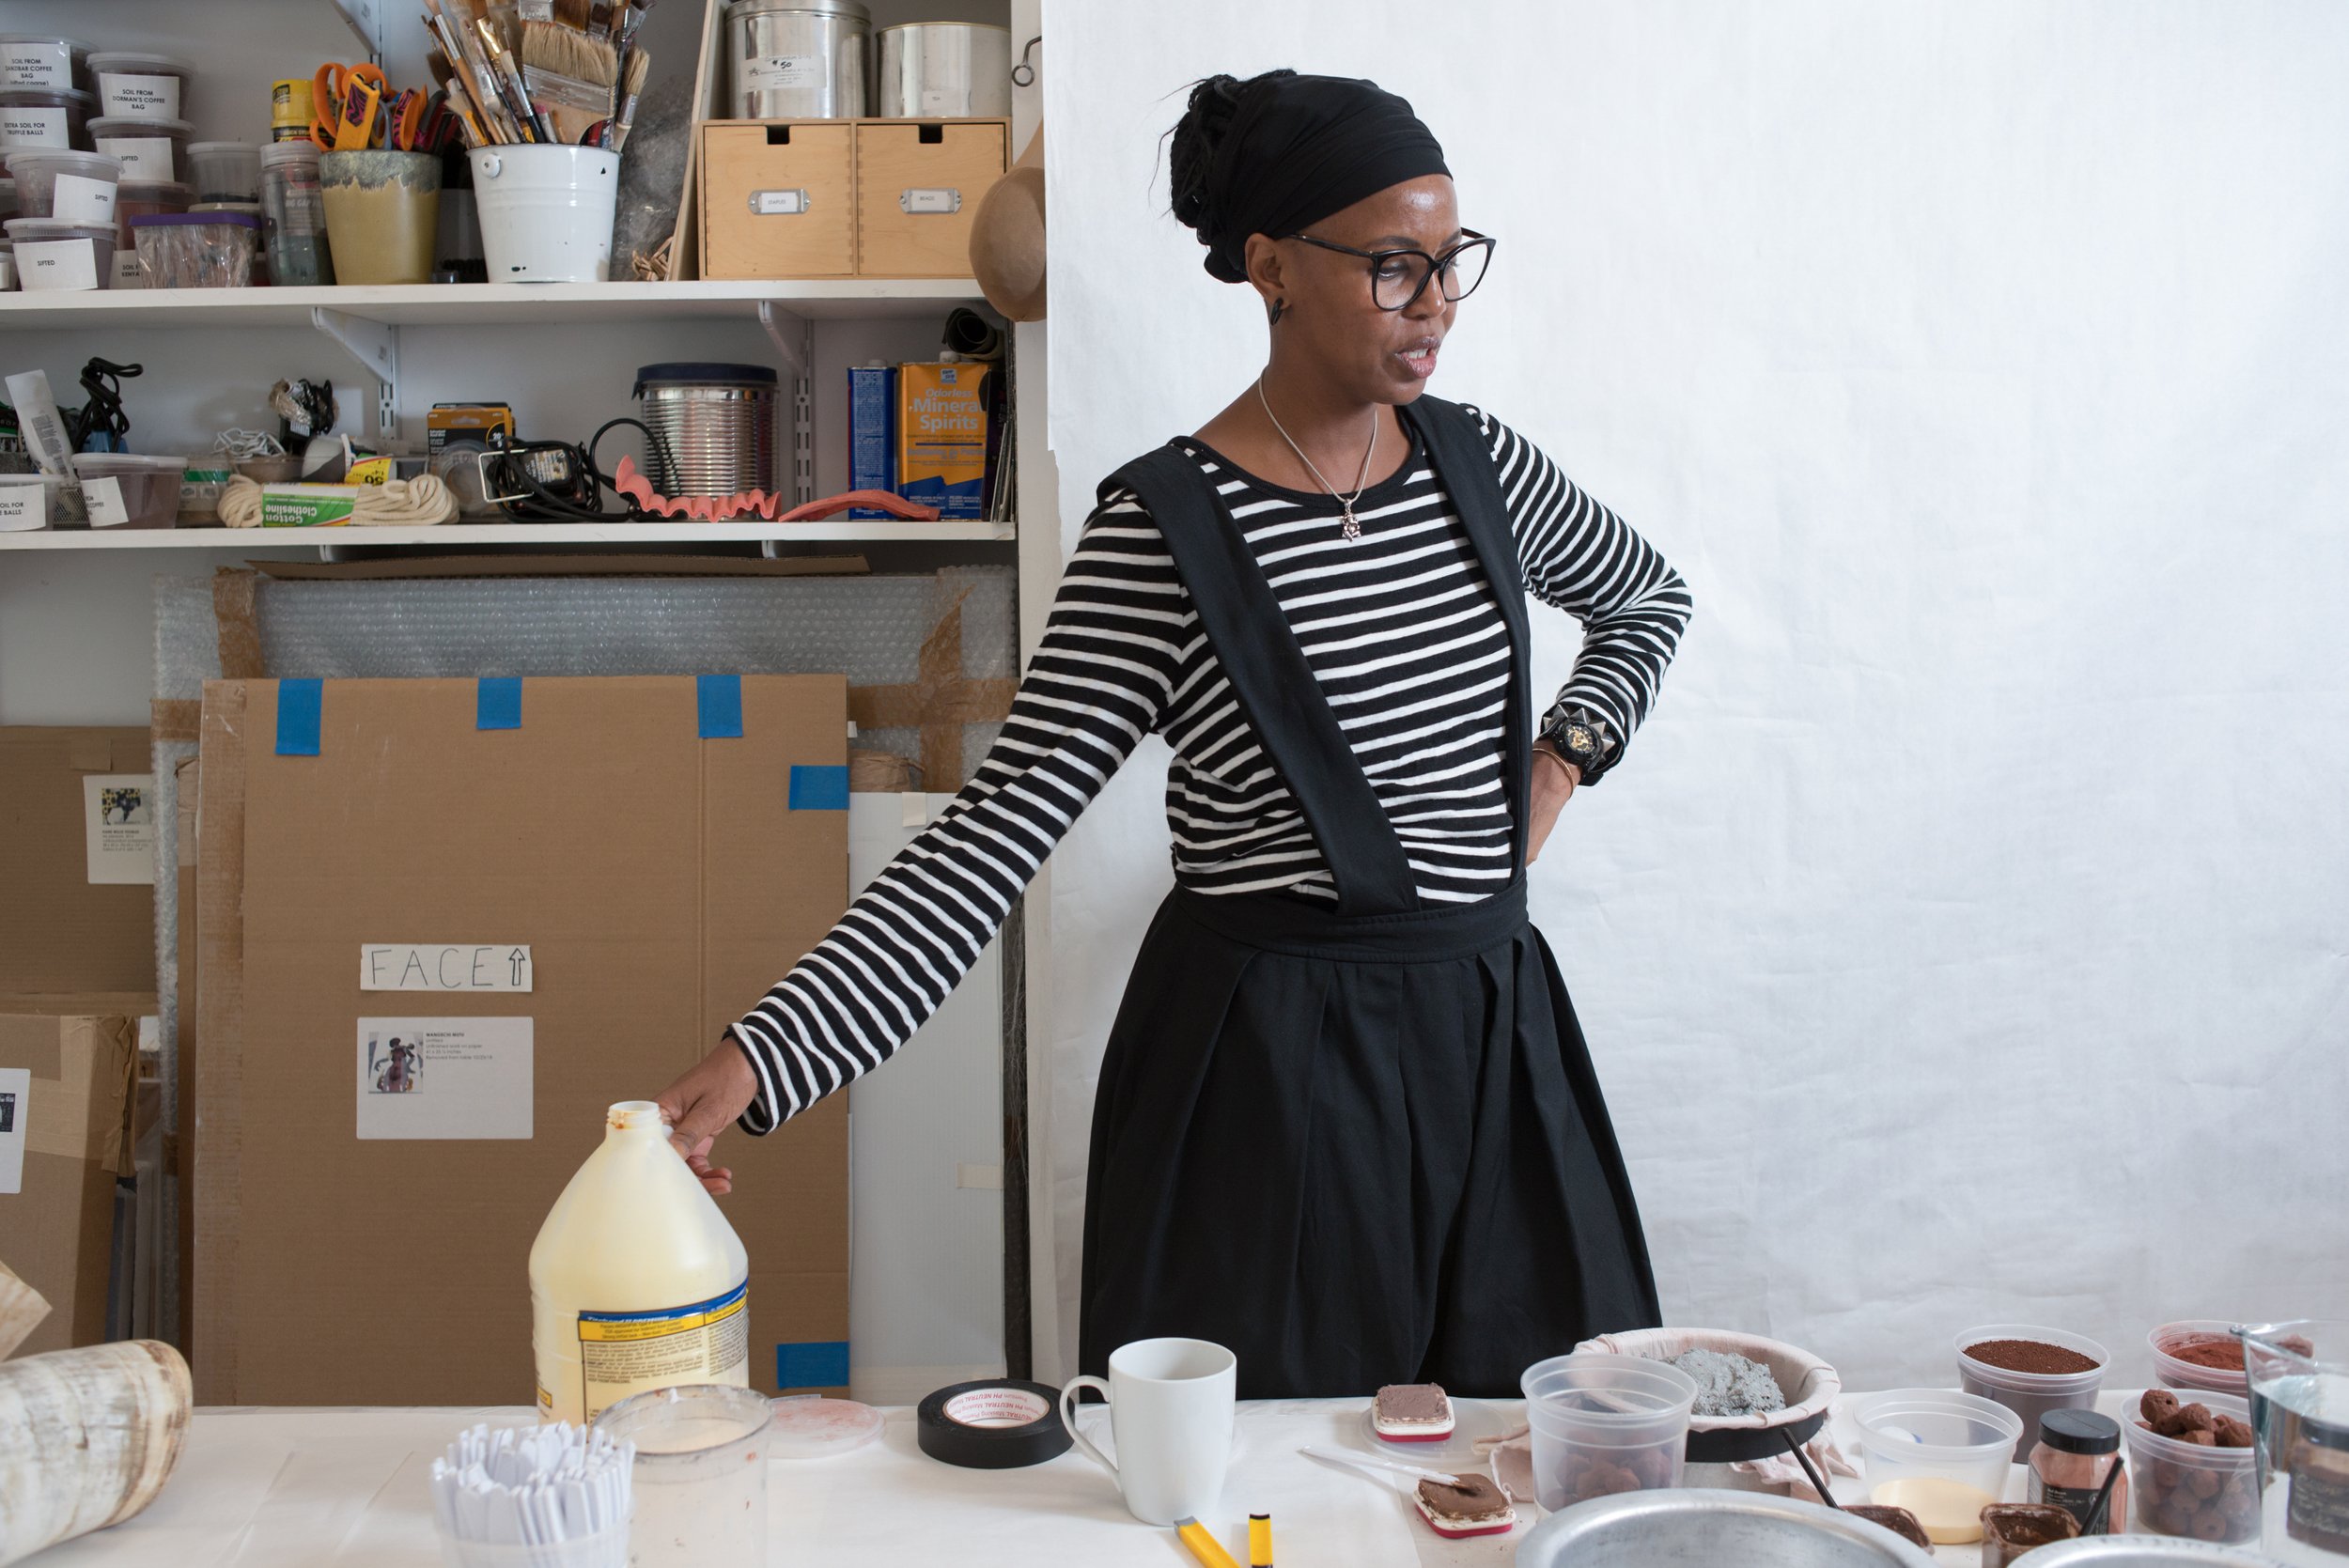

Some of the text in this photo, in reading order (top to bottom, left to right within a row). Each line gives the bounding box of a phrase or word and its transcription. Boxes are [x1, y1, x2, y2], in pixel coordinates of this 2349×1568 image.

[95, 194, 109, 202] SIFTED
[926, 387, 972, 398] Odorless
[919, 413, 979, 433] Spirits
[265, 504, 318, 517] Clothesline
[265, 514, 303, 523] Cotton
[371, 947, 494, 988] FACE
[965, 1393, 992, 1402] NEUTRAL
